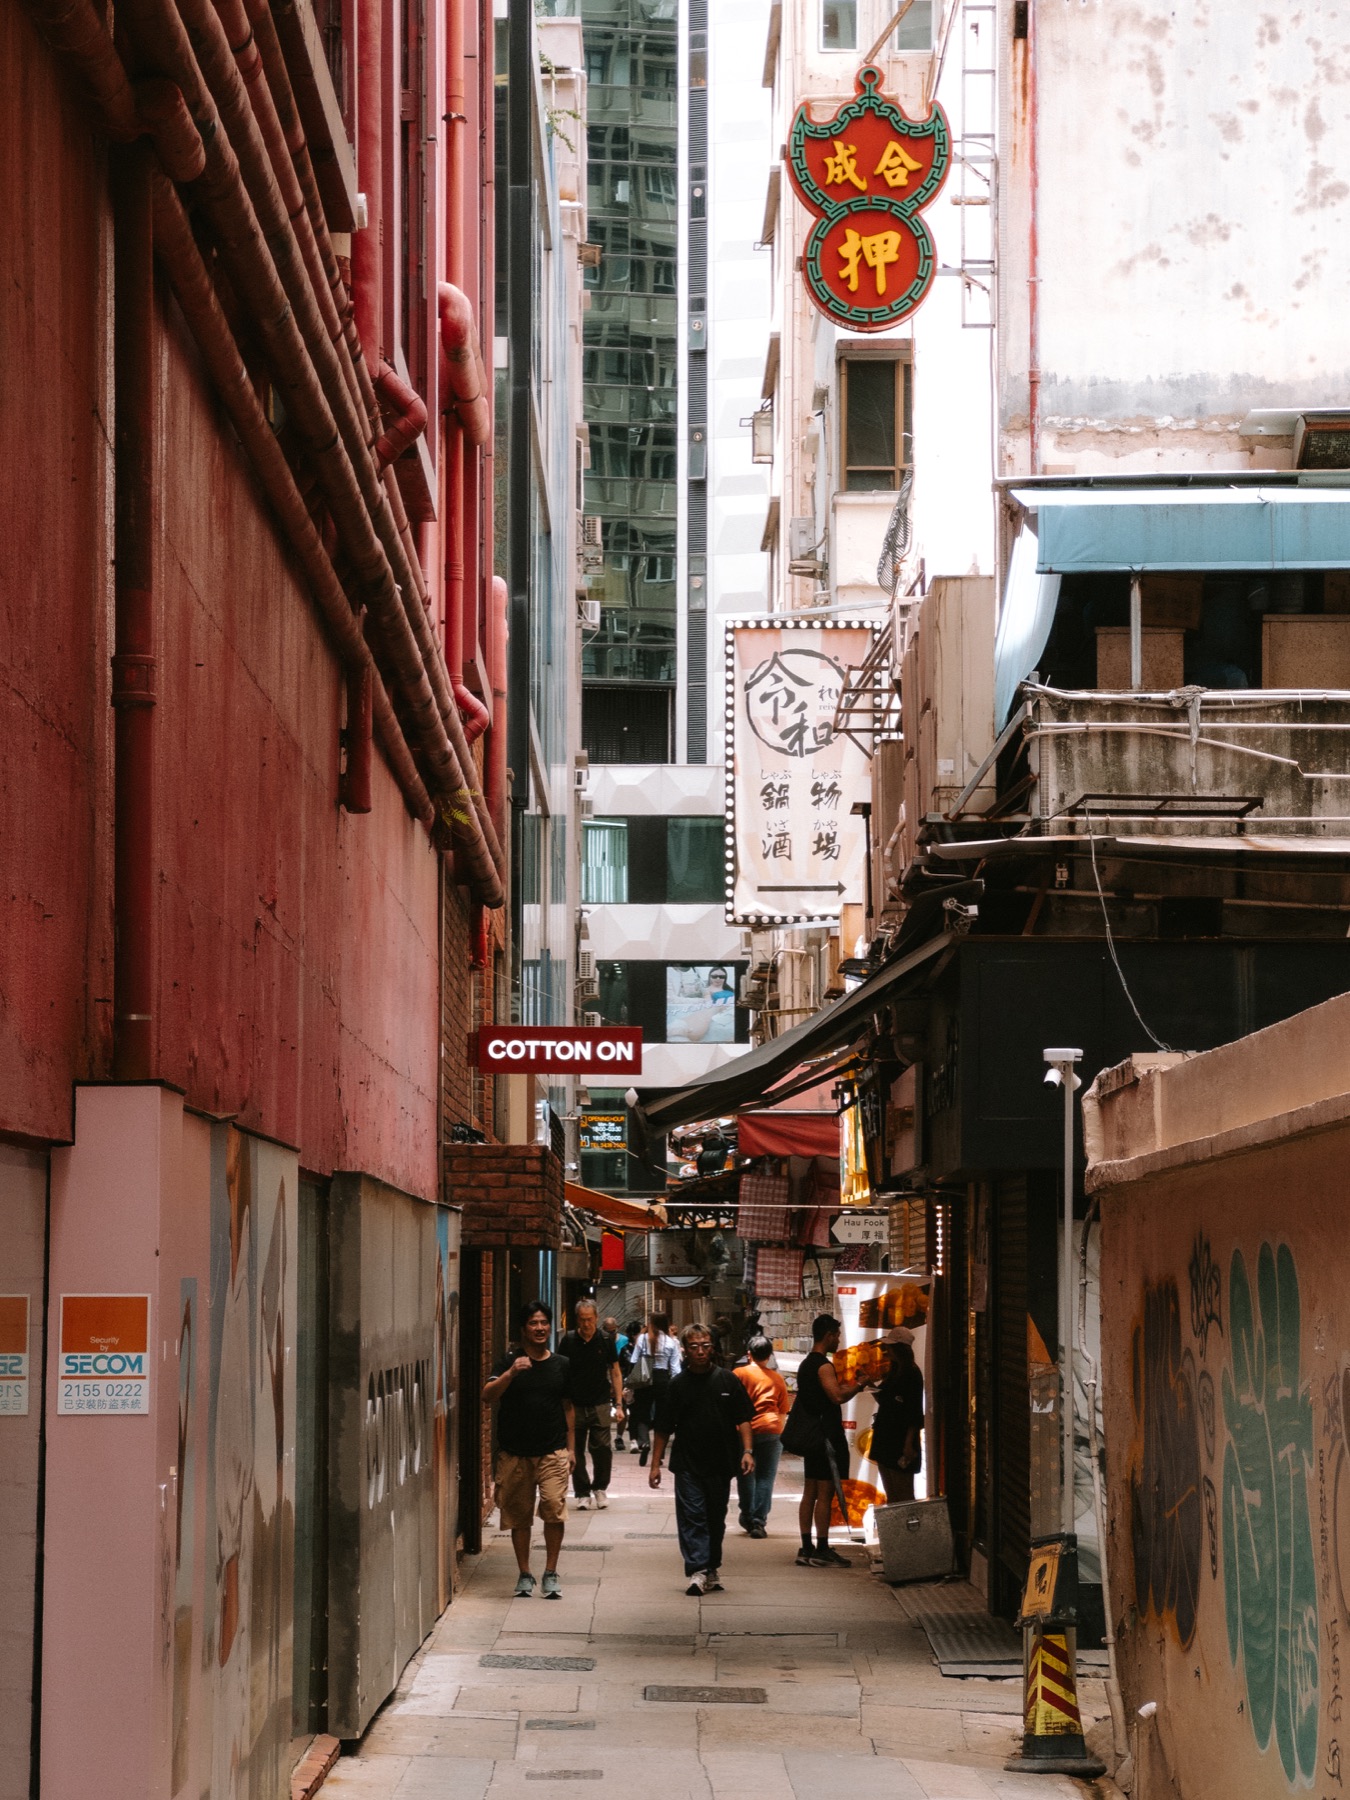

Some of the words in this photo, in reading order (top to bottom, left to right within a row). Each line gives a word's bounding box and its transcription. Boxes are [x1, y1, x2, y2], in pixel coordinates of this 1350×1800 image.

[838, 228, 901, 296] 押
[818, 703, 837, 711] reiw
[488, 1039, 591, 1061] COTTON
[596, 1041, 633, 1061] ON
[843, 1218, 861, 1227] Hau
[864, 1218, 885, 1227] Fook
[861, 1230, 889, 1240] 厚福
[90, 1336, 119, 1345] Security
[100, 1344, 109, 1352] by
[65, 1354, 143, 1375] SECOM
[64, 1384, 101, 1397] 2155
[105, 1384, 142, 1397] 0222
